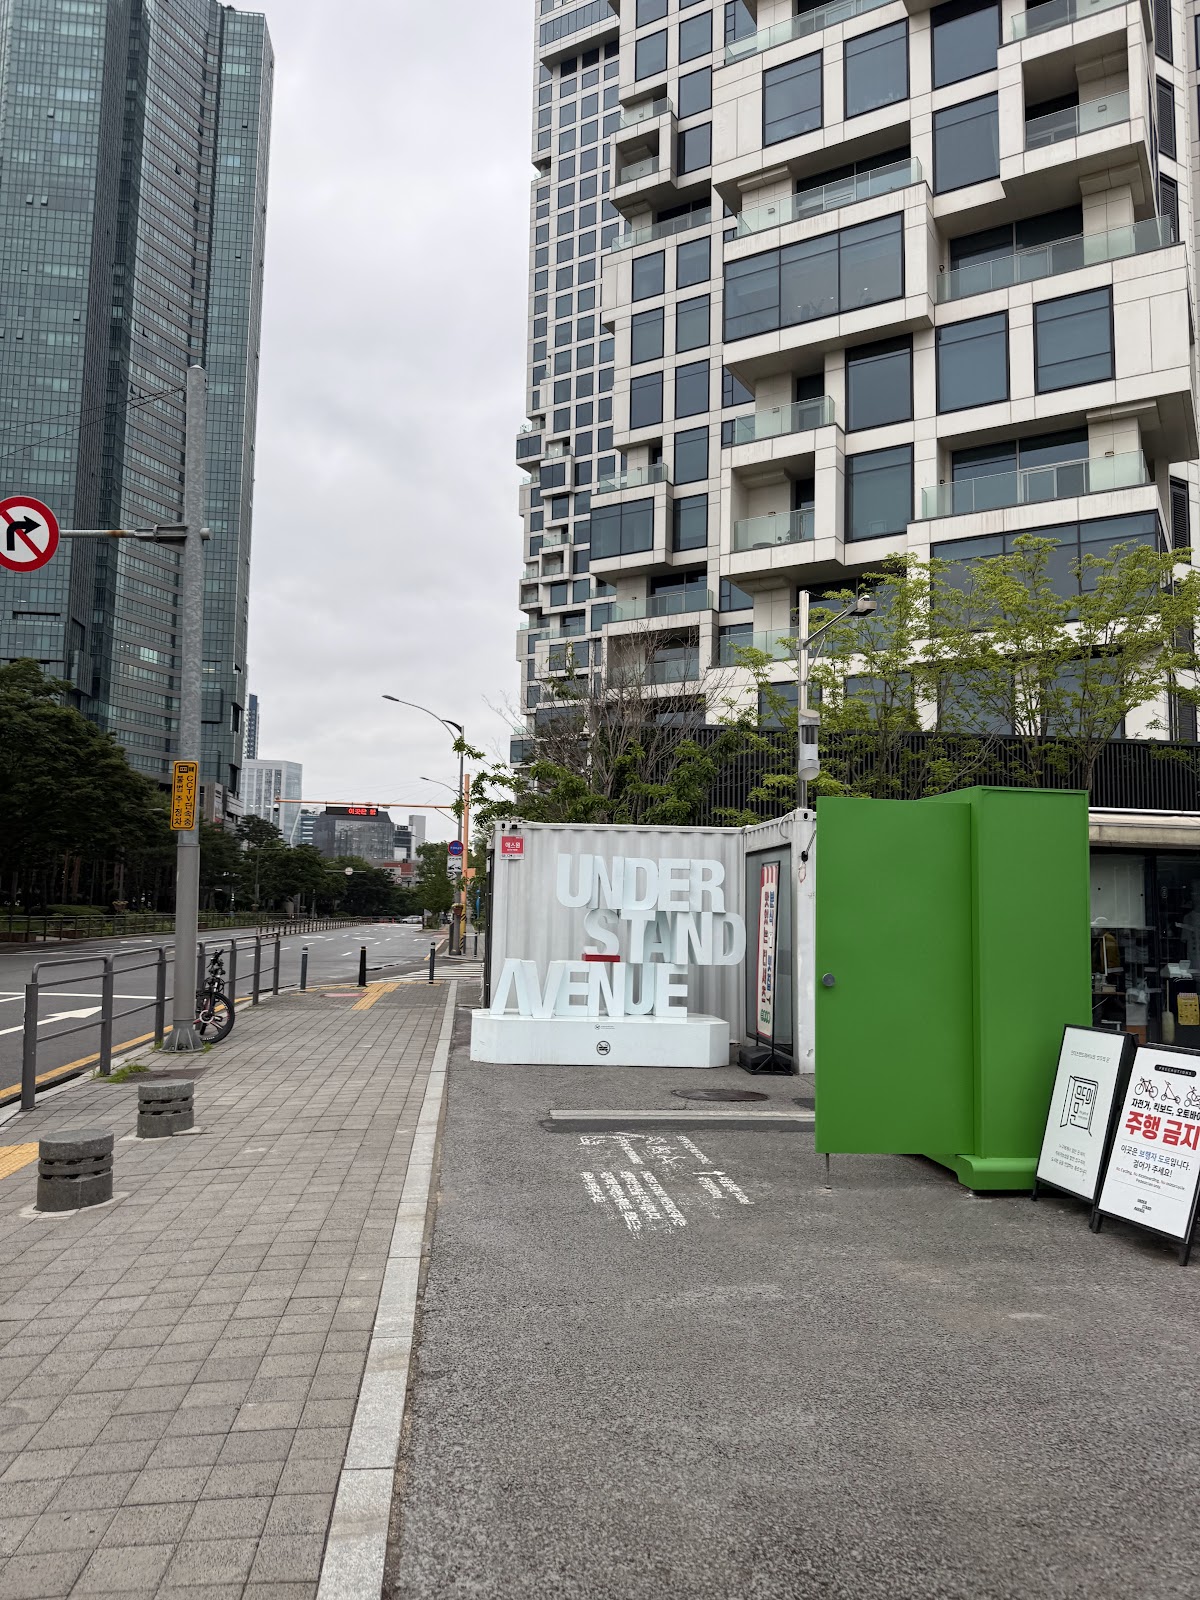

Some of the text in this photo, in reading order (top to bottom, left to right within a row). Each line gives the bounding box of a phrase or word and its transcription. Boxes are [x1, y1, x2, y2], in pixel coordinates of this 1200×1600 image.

[556, 853, 726, 914] UNDER
[583, 909, 746, 966] STAND
[490, 958, 688, 1019] AVENUE
[1158, 1066, 1192, 1076] PRECAUTIONS
[1131, 1098, 1152, 1111] 자전거,
[1153, 1102, 1174, 1116] 킥보드,
[1125, 1110, 1200, 1151] 주행 금지
[1120, 1144, 1190, 1171] 이곳은 보행자 도로입니다.
[1151, 1164, 1172, 1178] 주세요!
